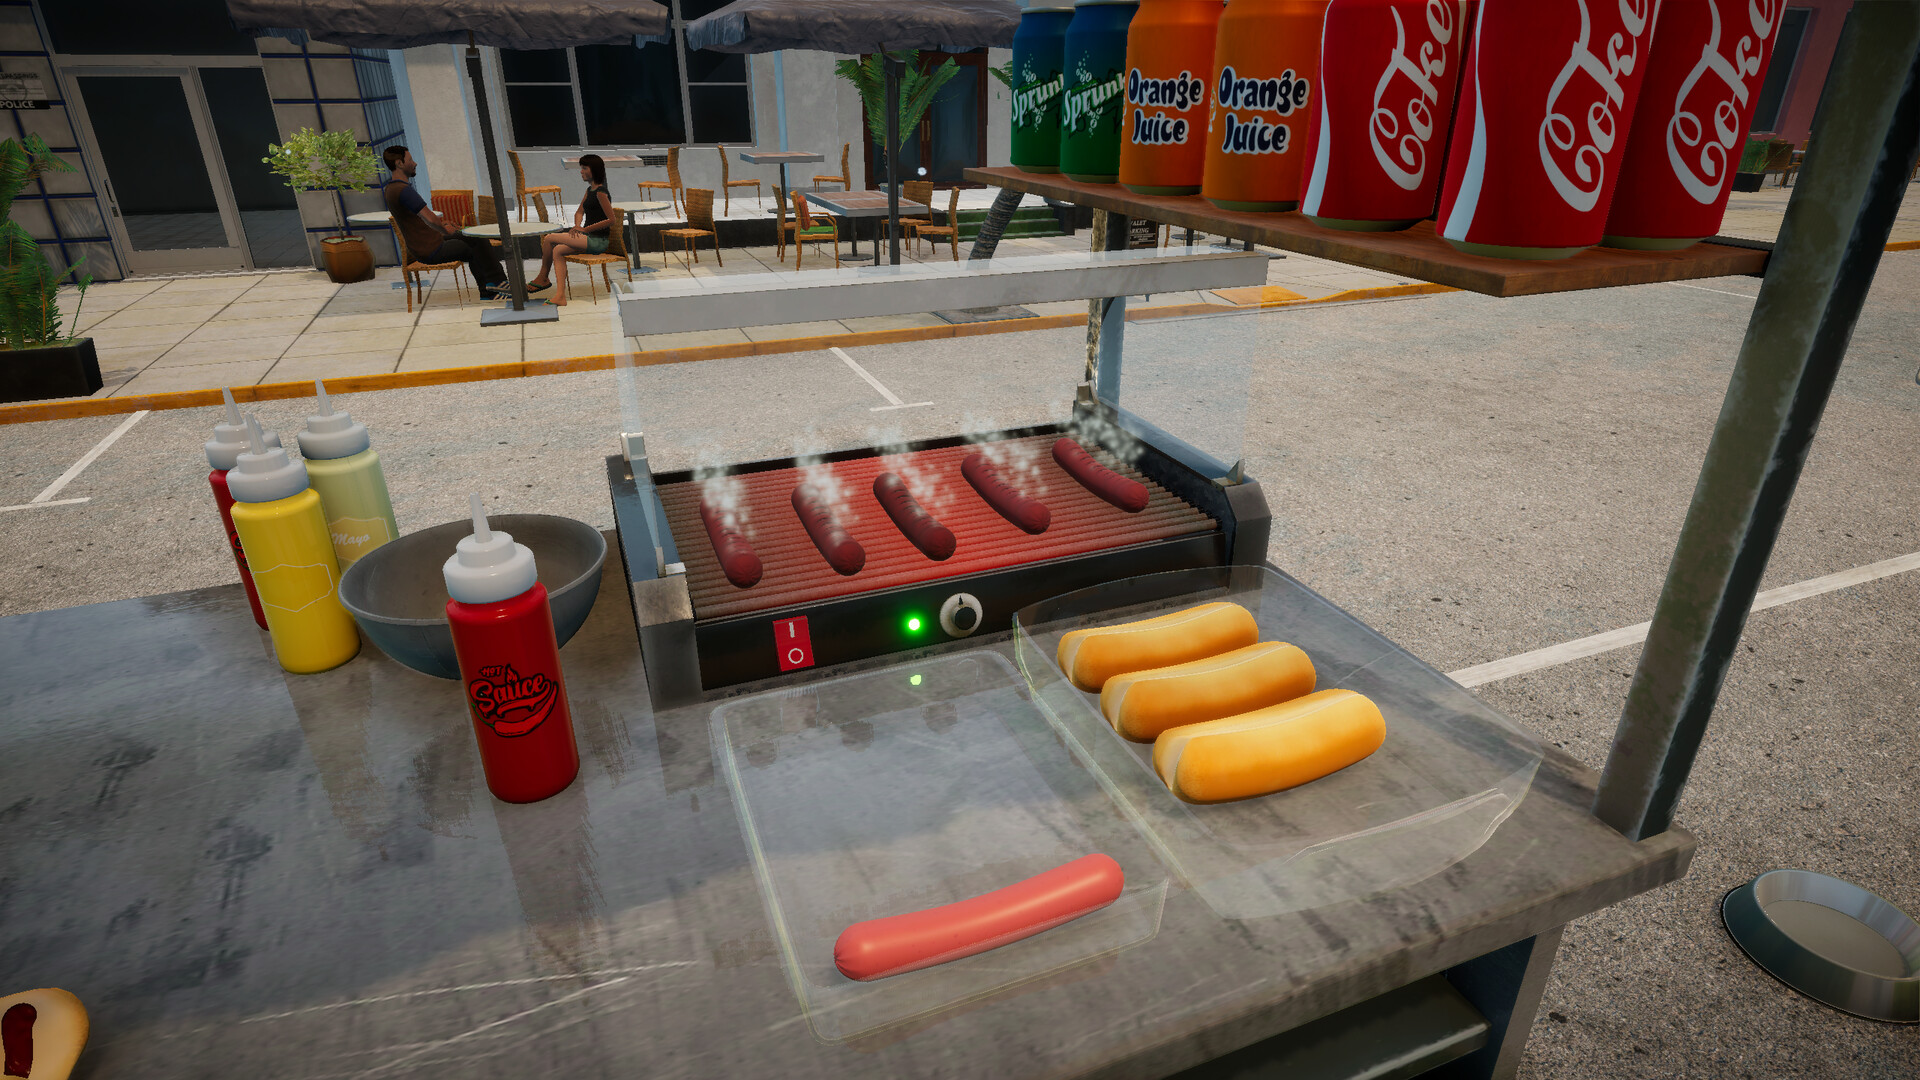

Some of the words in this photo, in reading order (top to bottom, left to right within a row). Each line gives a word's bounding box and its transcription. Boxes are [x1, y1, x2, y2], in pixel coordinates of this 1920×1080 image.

[0, 100, 36, 109] POLICE
[1127, 67, 1205, 112] Orange
[1218, 65, 1310, 117] Orange
[1369, 0, 1454, 191] Coke
[1132, 108, 1190, 144] Juice
[1222, 112, 1291, 154] Juice
[332, 532, 371, 548] Mayo
[479, 664, 504, 678] HOT
[469, 672, 552, 719] Sauce
